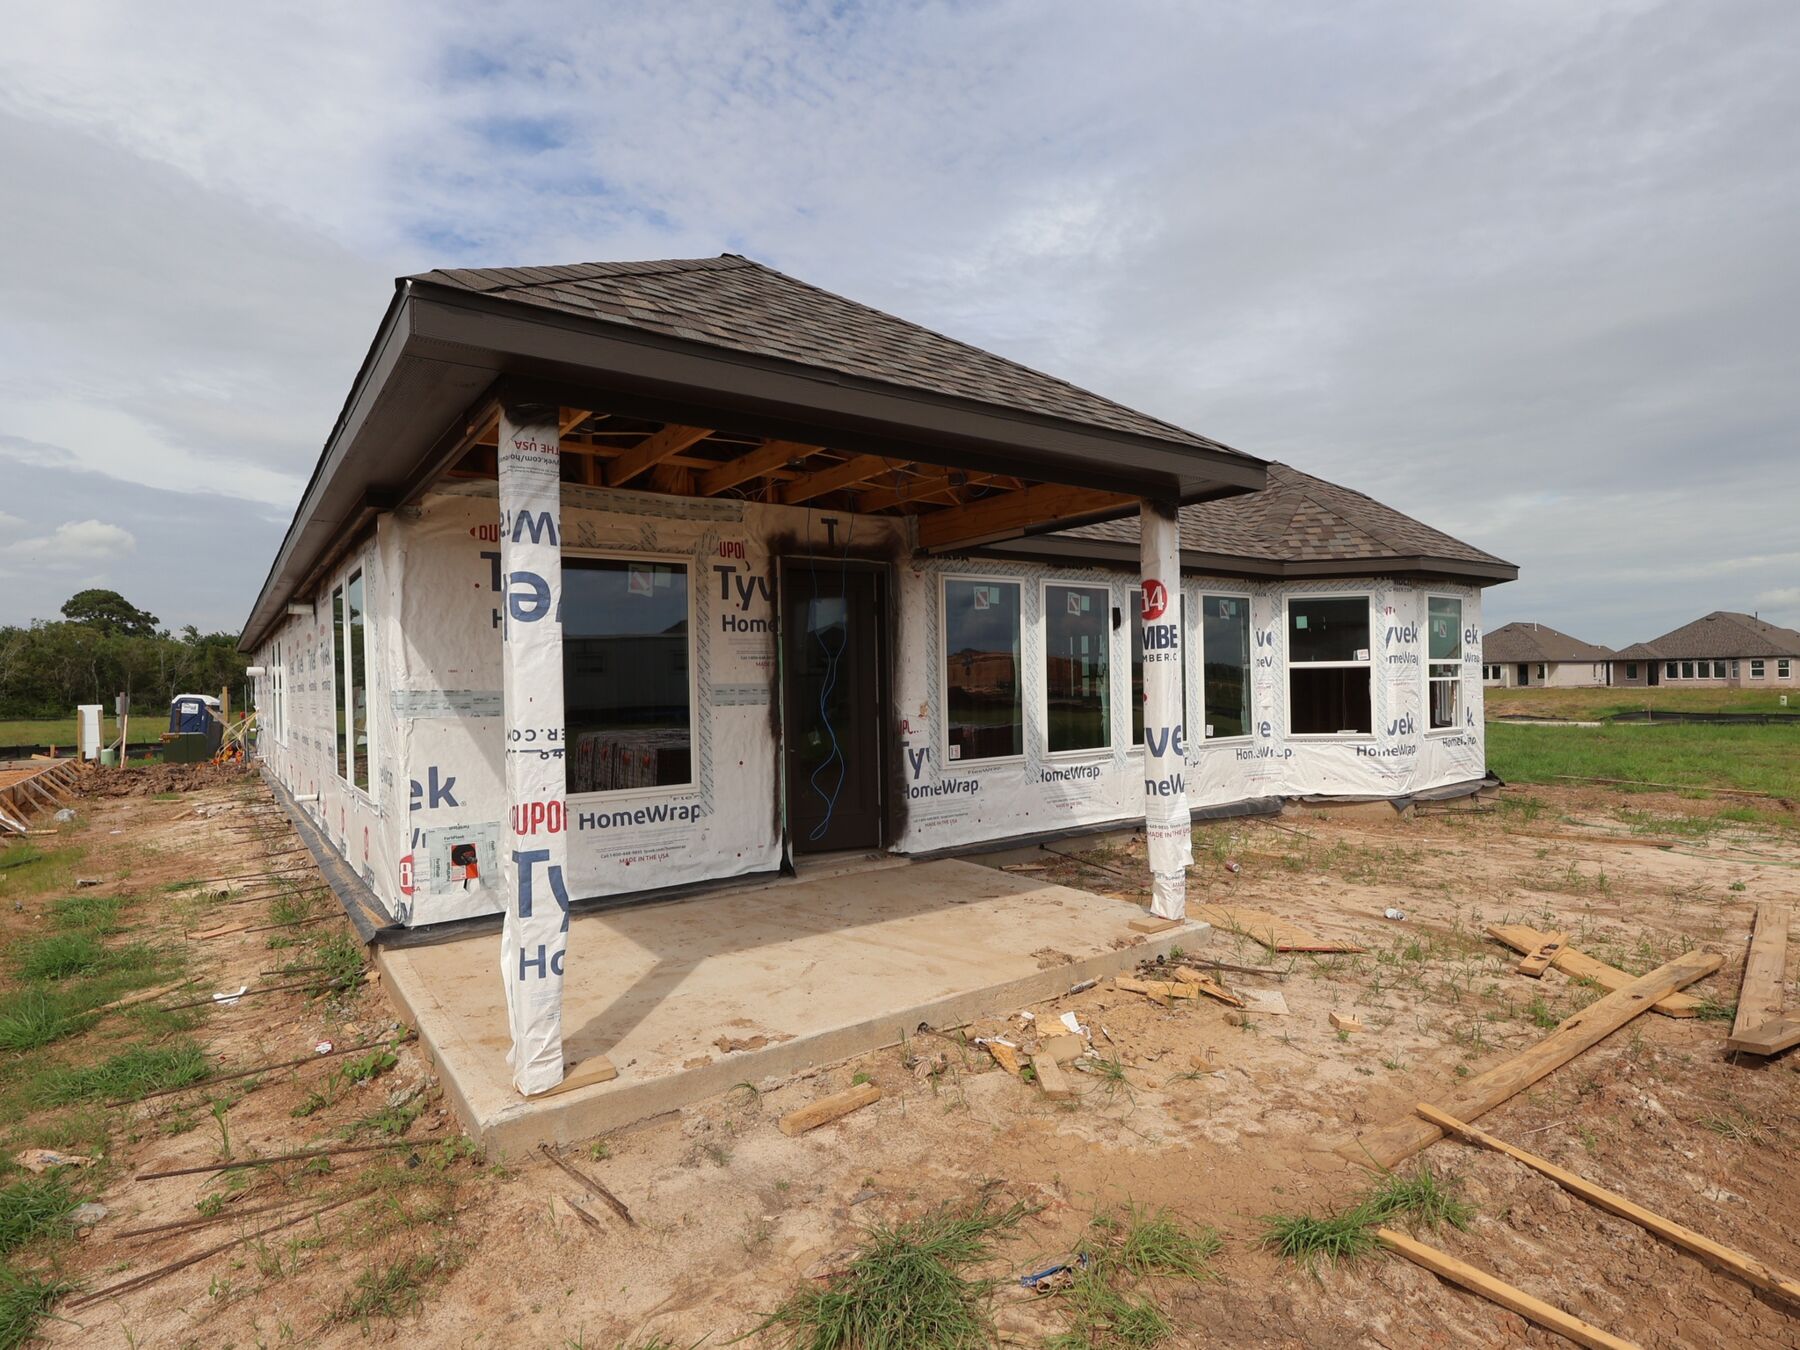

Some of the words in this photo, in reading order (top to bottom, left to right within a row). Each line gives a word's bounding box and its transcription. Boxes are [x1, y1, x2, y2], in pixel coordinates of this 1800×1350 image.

[1464, 624, 1479, 645] ek
[579, 804, 701, 831] HomeWrap
[658, 852, 670, 860] USA
